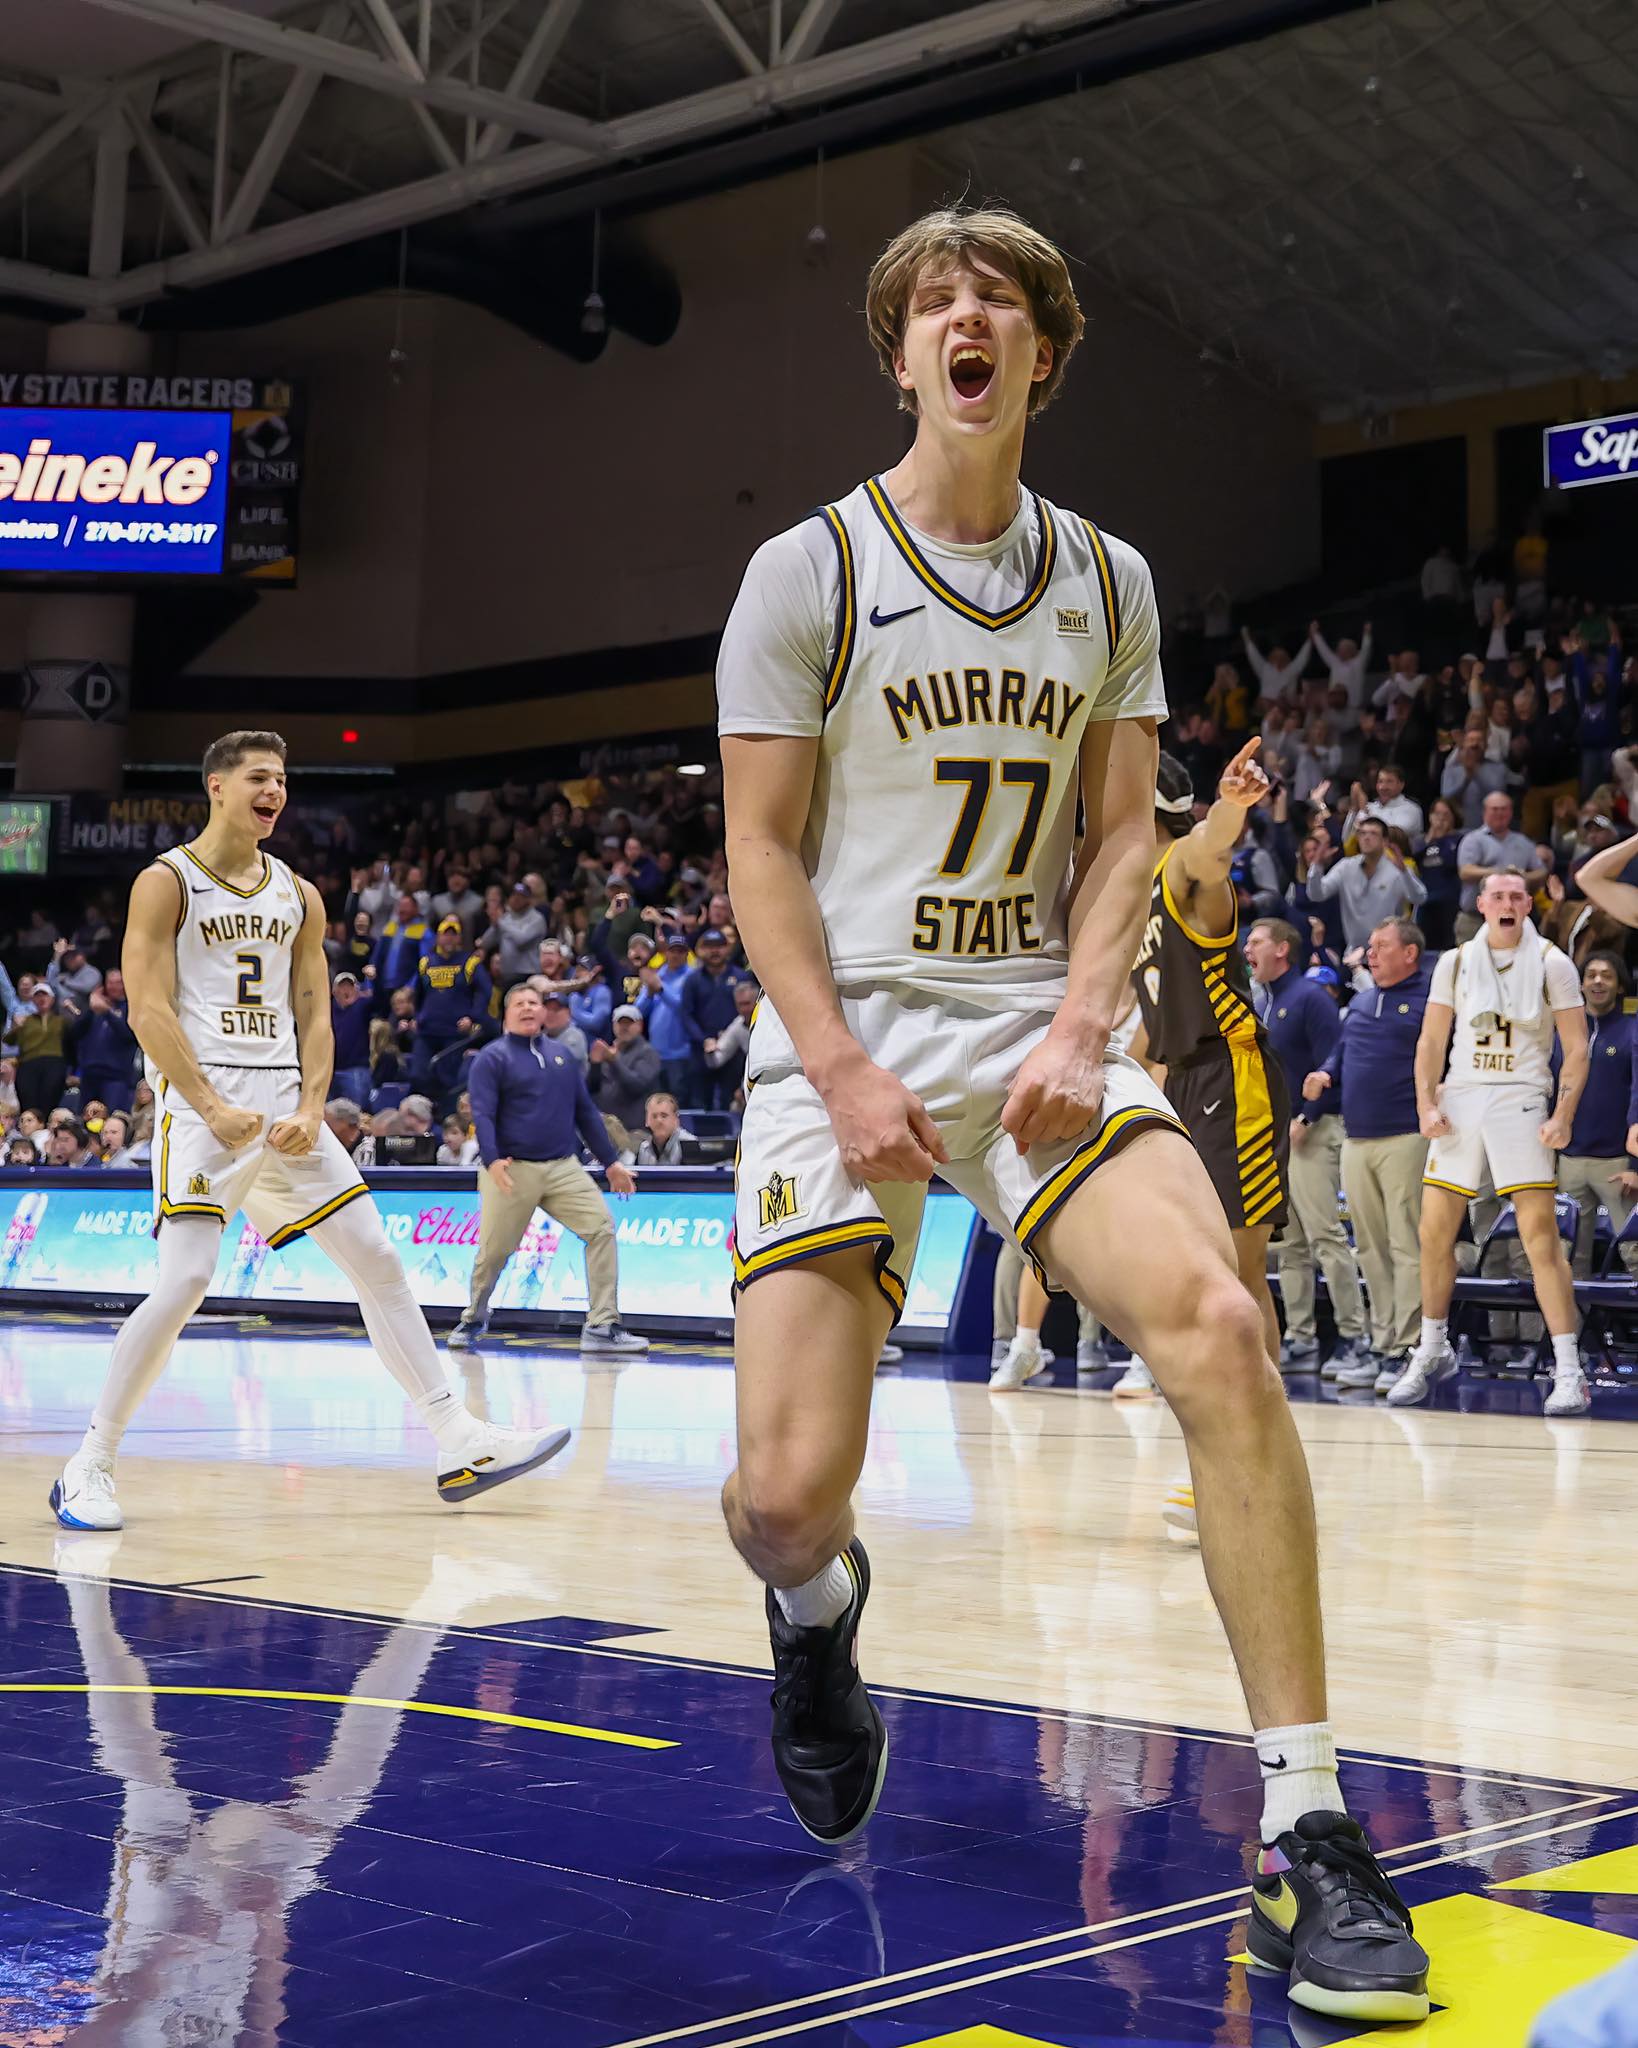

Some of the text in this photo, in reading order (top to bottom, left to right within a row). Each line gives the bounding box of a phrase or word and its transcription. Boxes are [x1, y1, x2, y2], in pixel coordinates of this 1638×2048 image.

[22, 374, 119, 405] STATE
[126, 378, 253, 408] RACERS
[1058, 611, 1088, 627] VALLEY
[881, 667, 1086, 743] MURRAY
[934, 757, 1050, 879] 77
[72, 822, 147, 848] HOME
[199, 914, 292, 946] MURRAY
[912, 893, 1041, 954] STATE
[236, 952, 263, 1007] 2
[221, 1010, 277, 1039] STATE
[1472, 1052, 1514, 1072] STATE
[73, 1210, 152, 1236] MADE TO
[616, 1218, 689, 1246] MADE
[691, 1218, 725, 1247] TO
